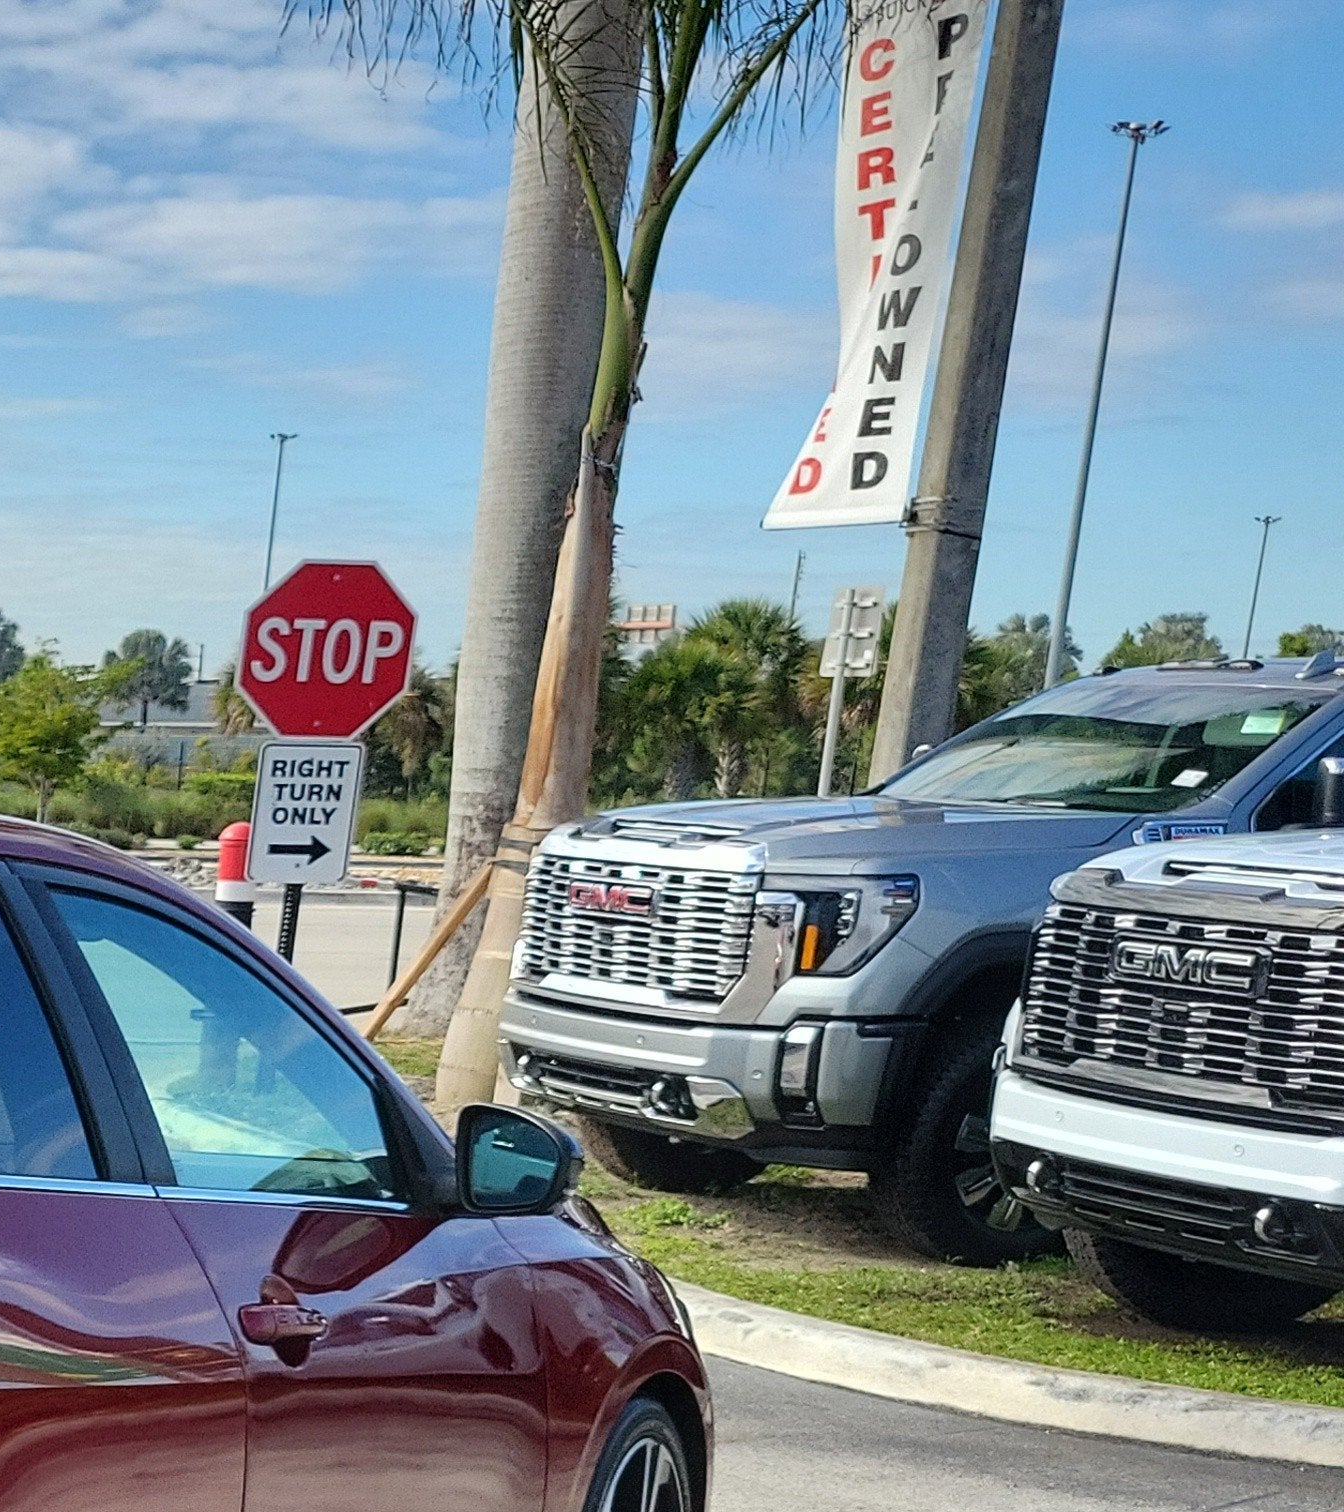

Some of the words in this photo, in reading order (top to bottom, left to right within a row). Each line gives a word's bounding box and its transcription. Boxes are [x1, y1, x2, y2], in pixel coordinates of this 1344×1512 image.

[250, 616, 405, 684] STOP
[271, 759, 350, 778] RIGHT
[273, 783, 343, 802] TURN
[271, 807, 338, 825] ONLY
[568, 882, 652, 915] GMC
[1116, 941, 1256, 989] GMC
